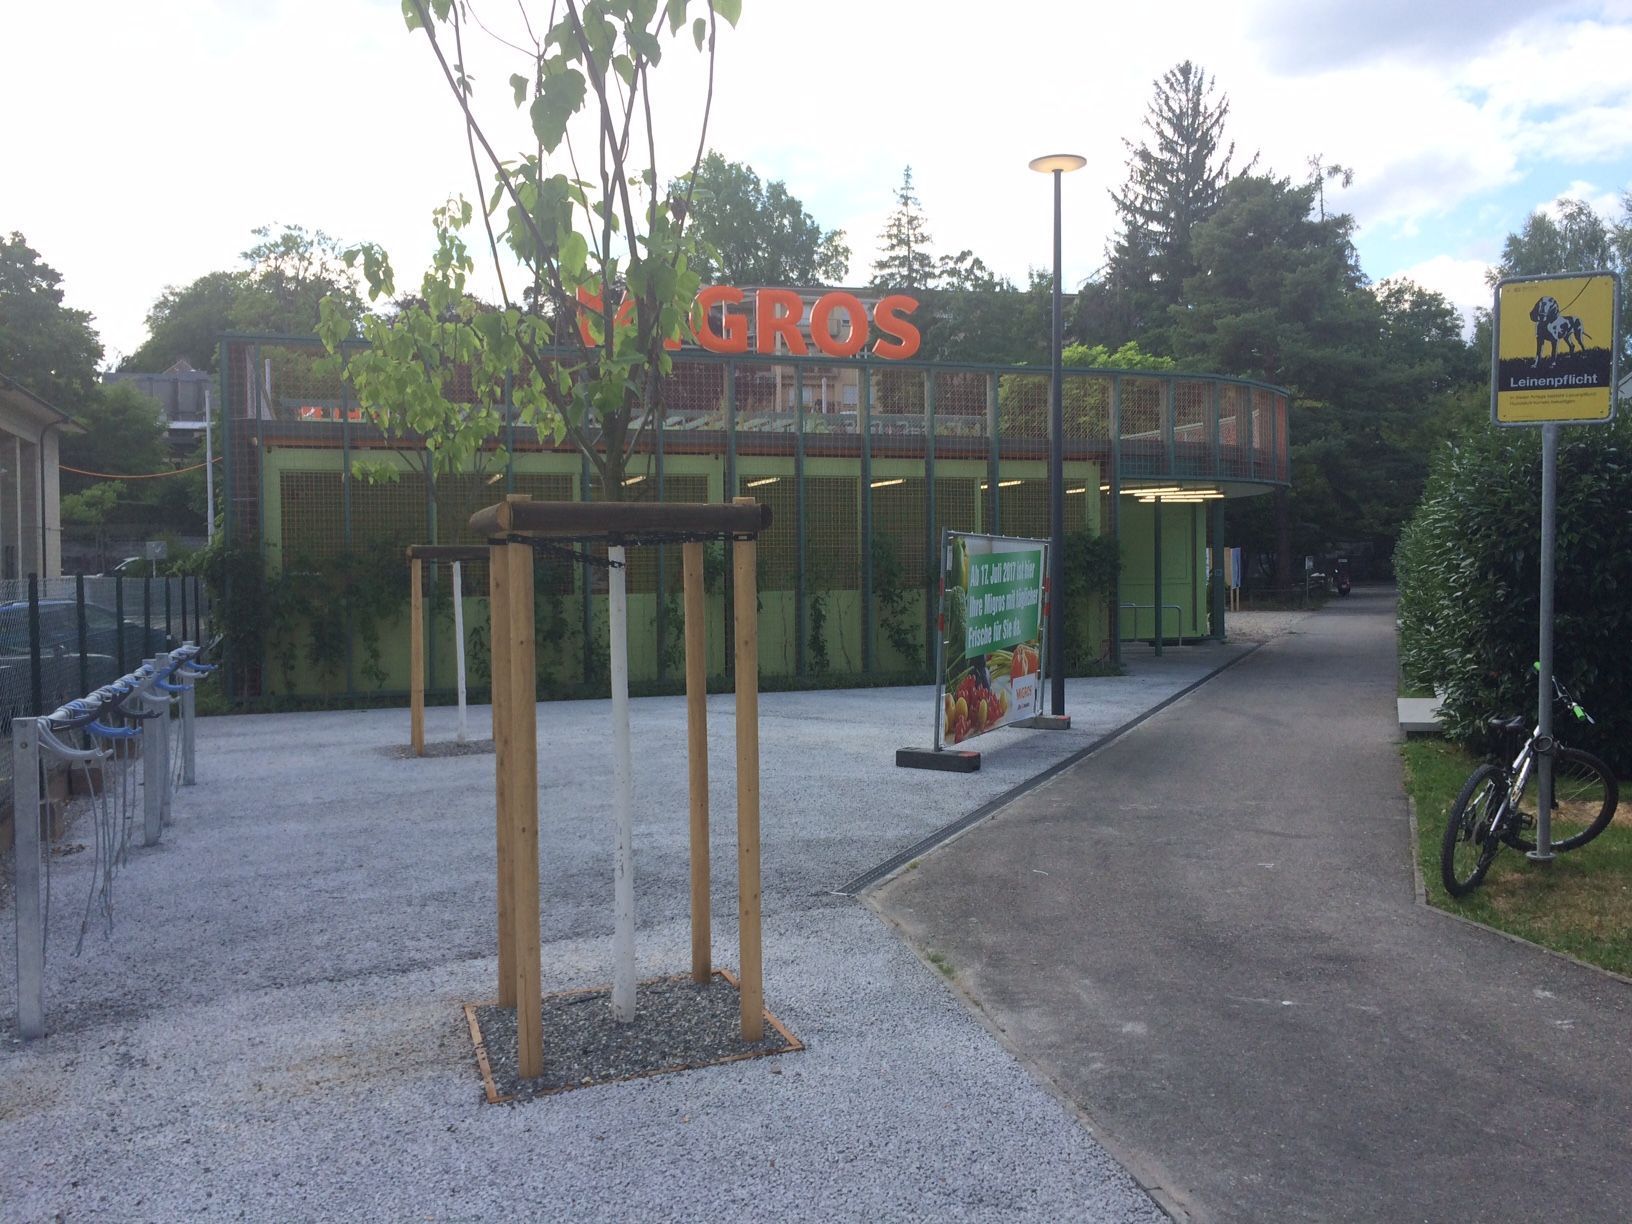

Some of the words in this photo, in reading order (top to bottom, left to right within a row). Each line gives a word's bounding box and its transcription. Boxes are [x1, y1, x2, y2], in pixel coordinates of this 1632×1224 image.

[576, 284, 922, 361] GROS
[1510, 373, 1598, 387] Leinenpflicht
[970, 563, 980, 587] Ab
[981, 563, 989, 586] 17.
[990, 562, 1002, 585] Juli
[1003, 561, 1016, 583] 2017
[1016, 560, 1024, 580] ist
[1025, 559, 1036, 578] hier
[969, 595, 983, 618] Ihre
[984, 593, 1006, 616] Migros
[1006, 589, 1016, 611] mit
[1016, 587, 1038, 610] täglicher
[968, 623, 992, 649] Frische
[993, 620, 1002, 642] für
[1002, 618, 1012, 640] Sie
